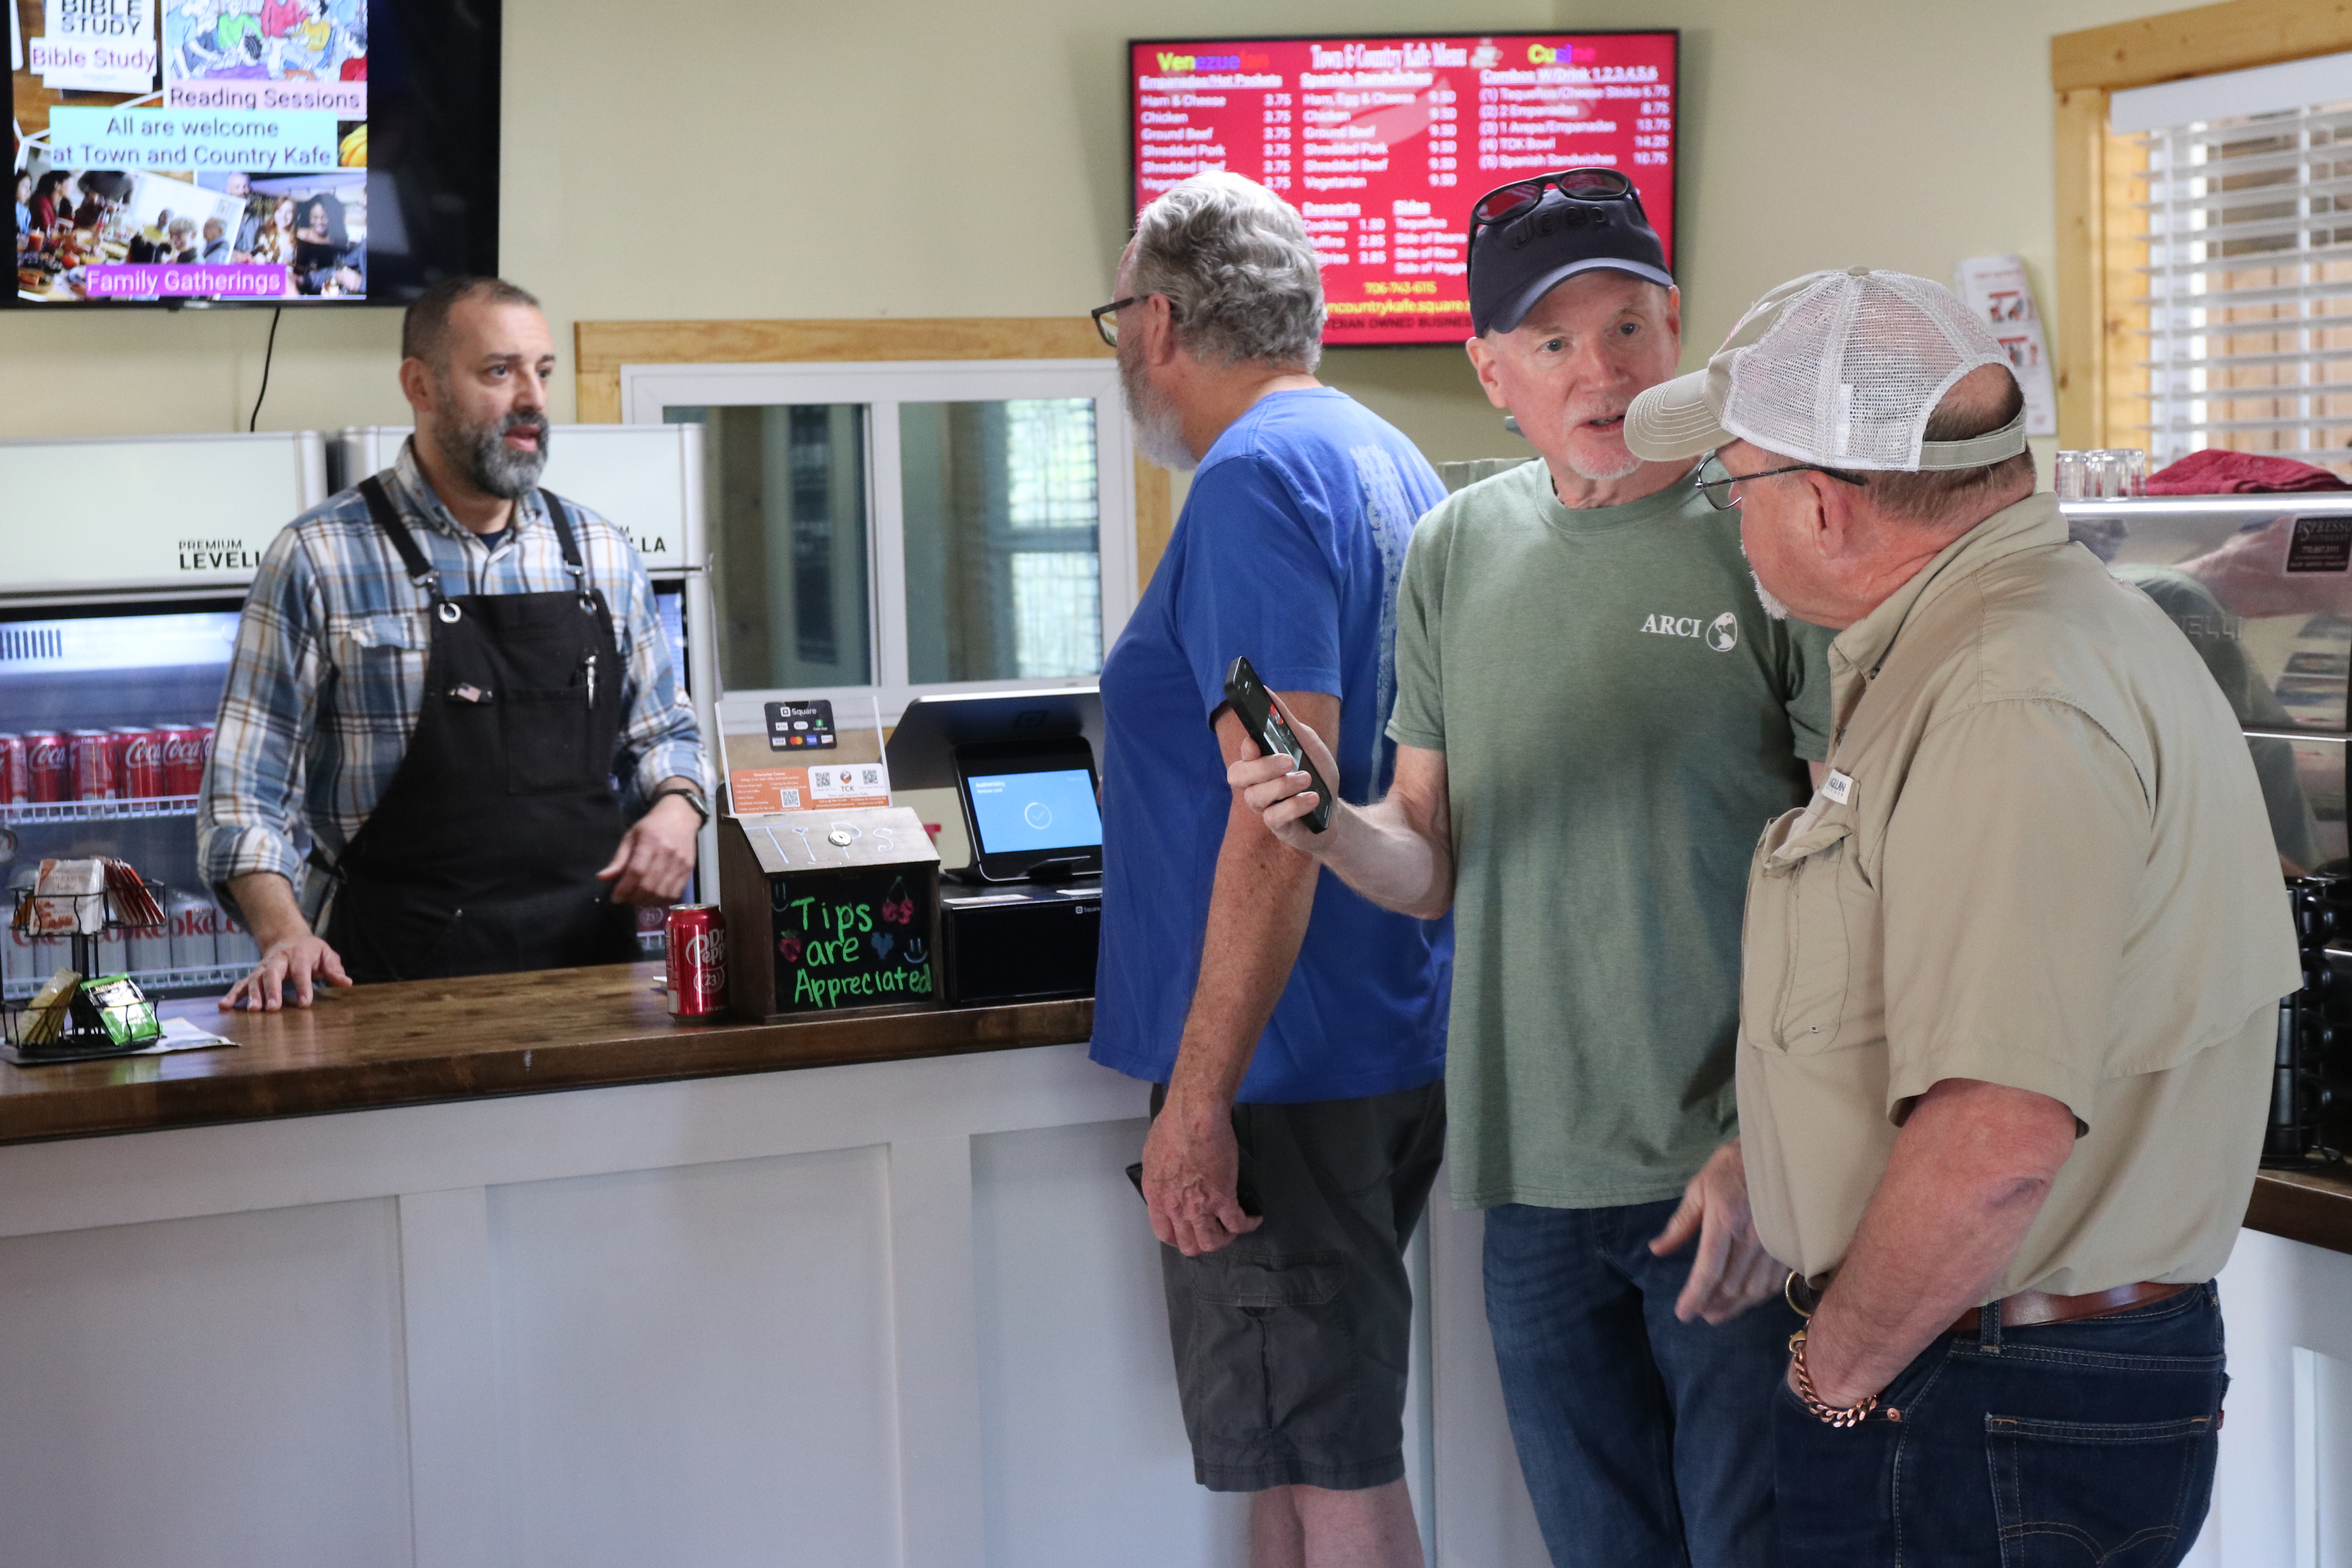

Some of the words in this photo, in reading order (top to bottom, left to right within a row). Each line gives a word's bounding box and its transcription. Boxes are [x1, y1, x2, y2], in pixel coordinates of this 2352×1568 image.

[62, 0, 142, 17] BIBLE
[62, 16, 140, 35] STUDY
[33, 47, 85, 67] Bible
[94, 48, 156, 73] Study
[1310, 44, 1343, 70] Town
[1355, 44, 1403, 74] Country
[1403, 42, 1432, 68] Kafe
[1432, 42, 1468, 67] Menu
[1300, 71, 1354, 89] Spanish
[1355, 71, 1433, 87] Sandwiches
[1480, 67, 1536, 84] Combos
[170, 87, 257, 111] Reading
[264, 88, 361, 110] Sessions
[1182, 94, 1227, 107] Cheese
[1263, 93, 1292, 107] 3.75
[1371, 91, 1416, 104] Cheese
[1140, 111, 1189, 125] Chicken
[1263, 110, 1291, 124] 3.75
[1303, 110, 1351, 123] Chicken
[1499, 105, 1508, 117] 2
[1509, 103, 1579, 119] Empanadas
[106, 117, 134, 136] All
[141, 119, 175, 137] are
[181, 118, 279, 138] welcome
[1140, 127, 1184, 141] Ground
[1185, 127, 1214, 141] Beef
[1263, 127, 1291, 140] 3.75
[1303, 126, 1347, 140] Ground
[1348, 125, 1376, 138] Beef
[1499, 121, 1508, 134] 1
[1141, 144, 1197, 157] Shredded
[1198, 143, 1226, 157] Pork
[1263, 143, 1291, 157] 3.75
[1303, 143, 1359, 156] Shredded
[1360, 142, 1389, 155] Pork
[1526, 136, 1556, 150] Bowl
[52, 147, 73, 165] at
[79, 145, 142, 166] Town
[147, 145, 187, 165] and
[192, 146, 278, 169] Country
[283, 147, 332, 166] Kafe
[1499, 153, 1546, 169] Spanish
[1546, 152, 1617, 167] Sandwiches
[1141, 160, 1197, 174] Shredded
[1263, 160, 1291, 174] 3.75
[1303, 159, 1359, 173] Shredded
[1360, 158, 1389, 172] Beef
[1303, 175, 1367, 191] Vegetarian
[1302, 201, 1361, 218] Desserts
[1392, 199, 1431, 216] Sides
[1303, 219, 1349, 232] Cookies
[1358, 218, 1386, 232] 1.50
[1513, 205, 1606, 249] Jeep
[1394, 232, 1420, 245] Side
[1420, 231, 1433, 245] of
[1433, 231, 1468, 244] Beans
[1394, 247, 1420, 260] Side
[1420, 246, 1433, 260] of
[1433, 246, 1458, 260] Rice
[1394, 261, 1420, 275] Side
[1420, 261, 1433, 274] of
[86, 270, 158, 296] Family
[163, 270, 281, 296] Gatherings
[179, 538, 242, 550] PREMIUM
[1640, 613, 1702, 638] ARCI
[791, 708, 817, 716] Square
[791, 897, 873, 943] Tips
[708, 928, 725, 948] Dr
[686, 935, 725, 968] Pepp
[806, 937, 860, 967] are
[704, 974, 717, 986] 23
[795, 964, 933, 1009] Appreciated
